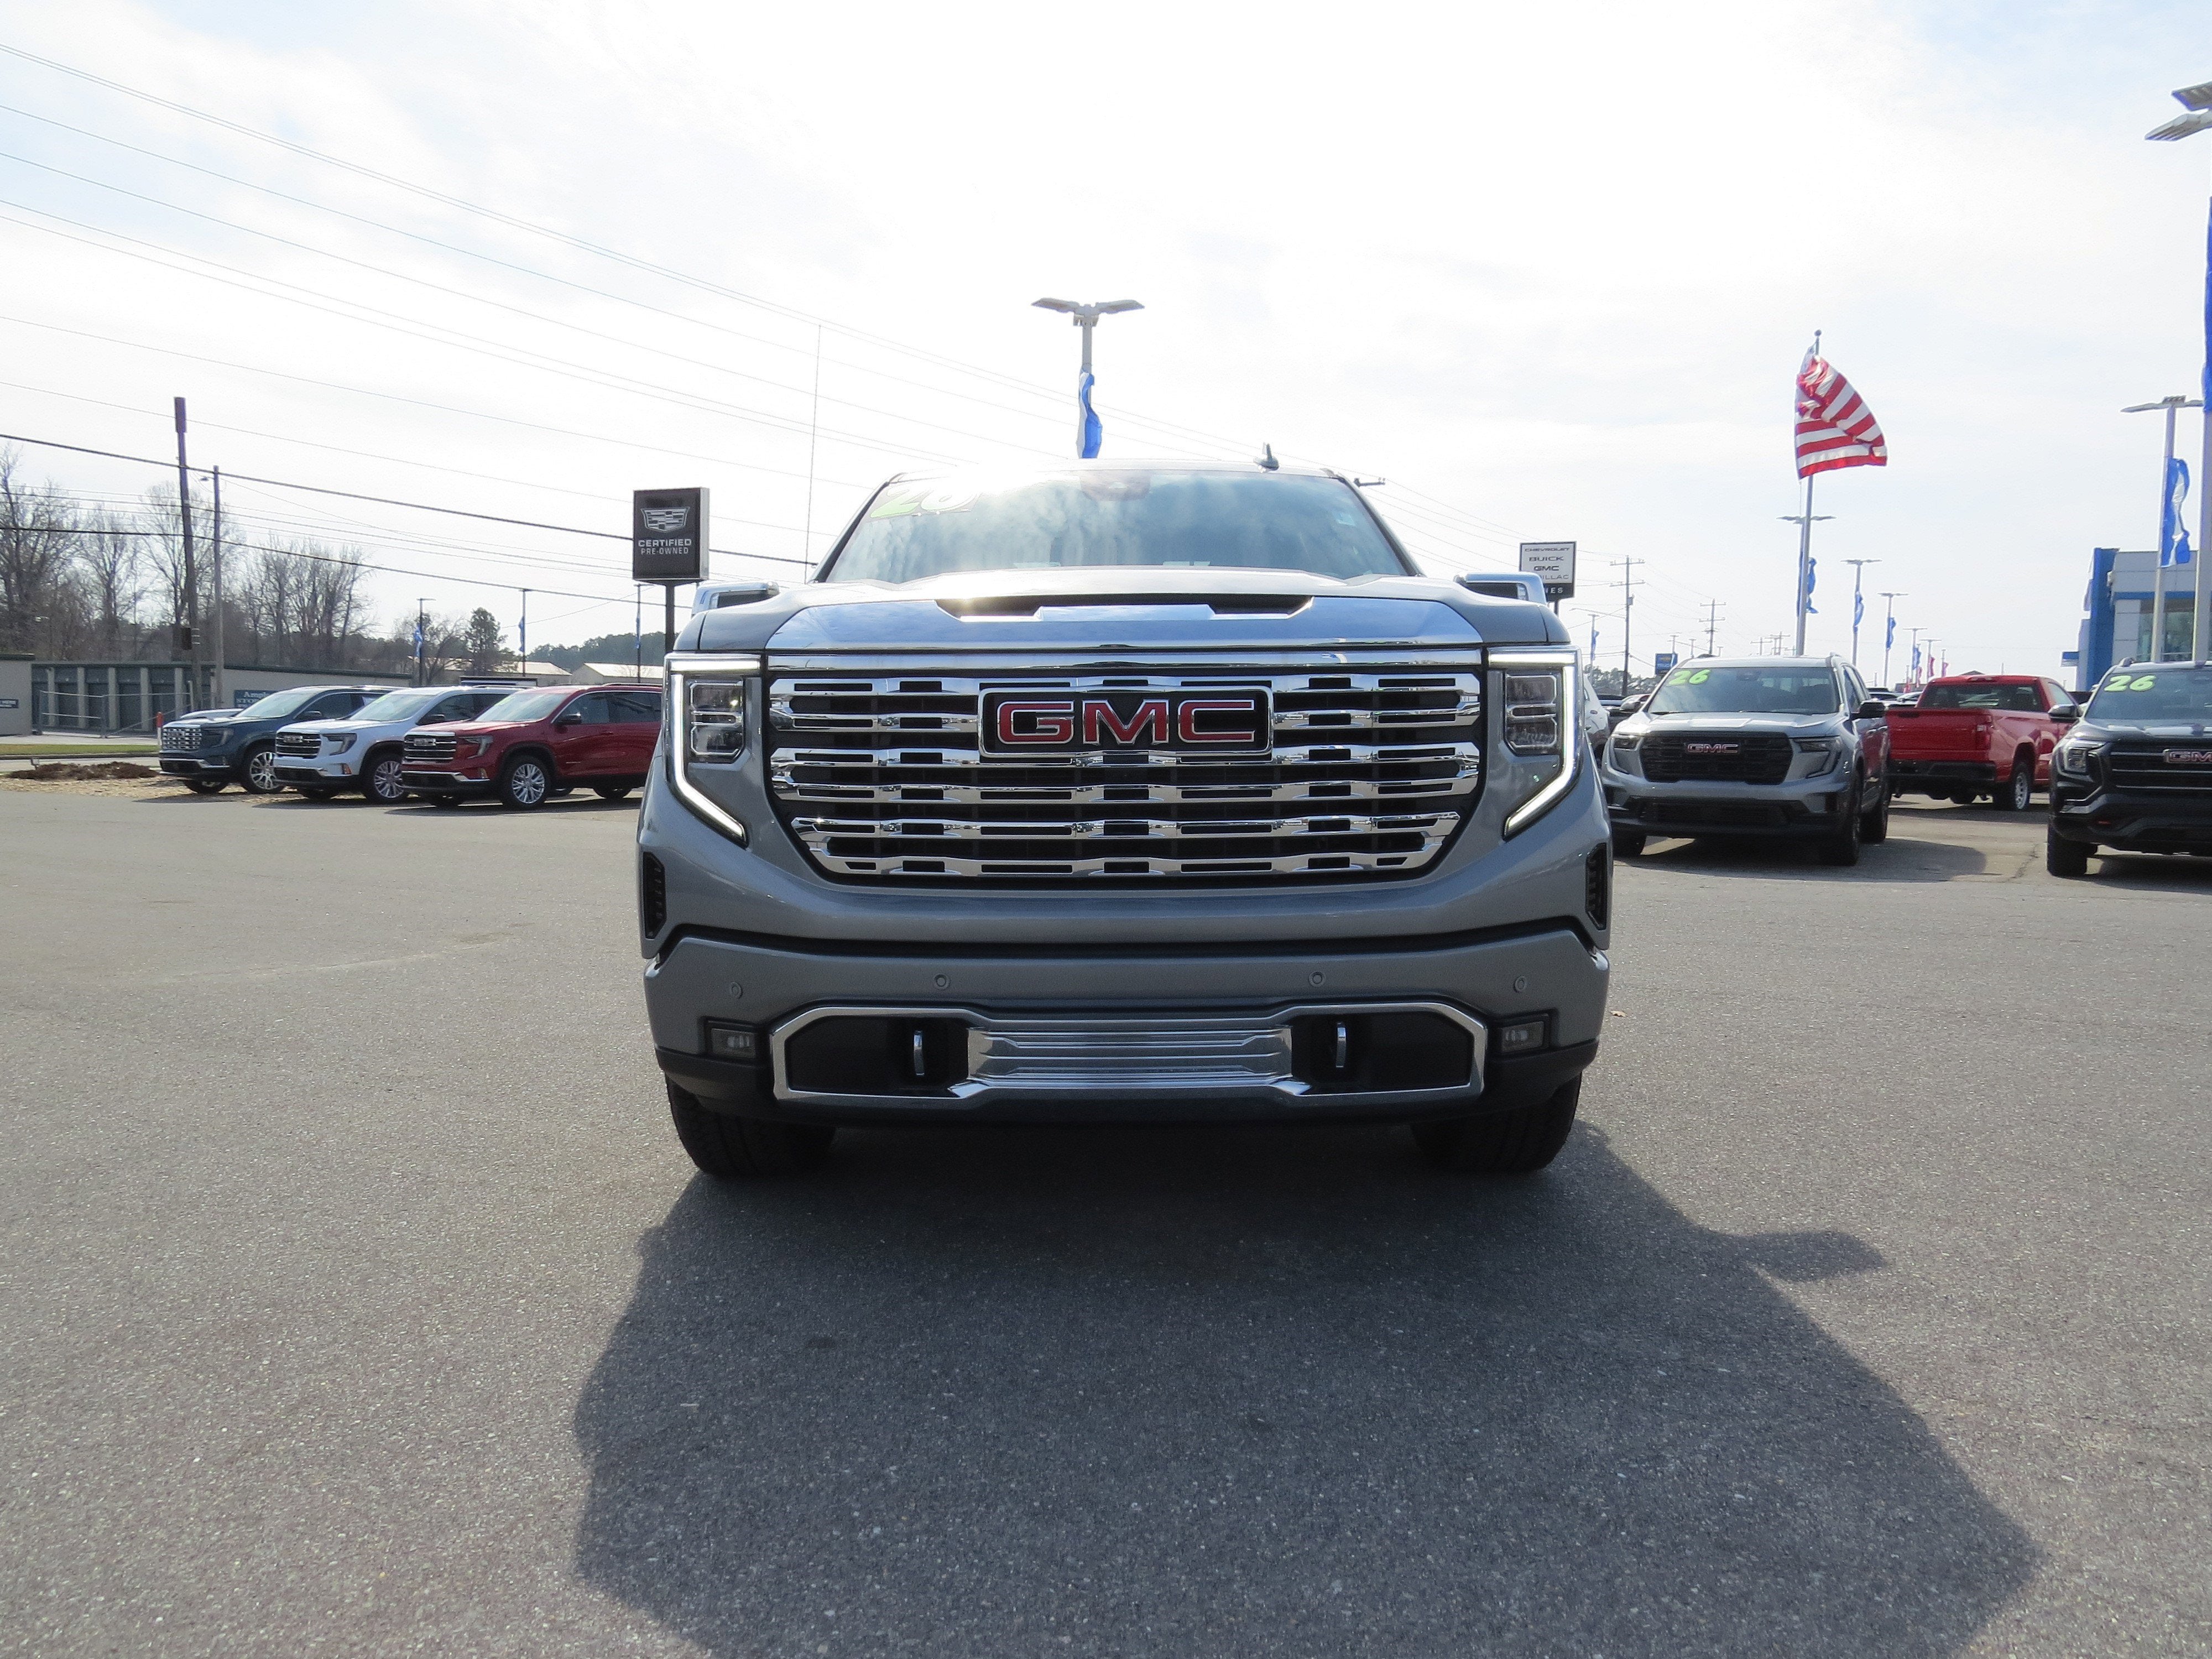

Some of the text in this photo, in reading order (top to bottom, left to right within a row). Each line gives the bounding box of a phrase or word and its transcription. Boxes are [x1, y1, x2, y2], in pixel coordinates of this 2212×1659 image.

[638, 539, 691, 547] CERTIFIED
[1668, 669, 1711, 685] 26
[2104, 675, 2157, 692] 26
[997, 698, 1255, 745] GMC
[1687, 743, 1739, 754] GMC
[2169, 751, 2212, 762] GM
